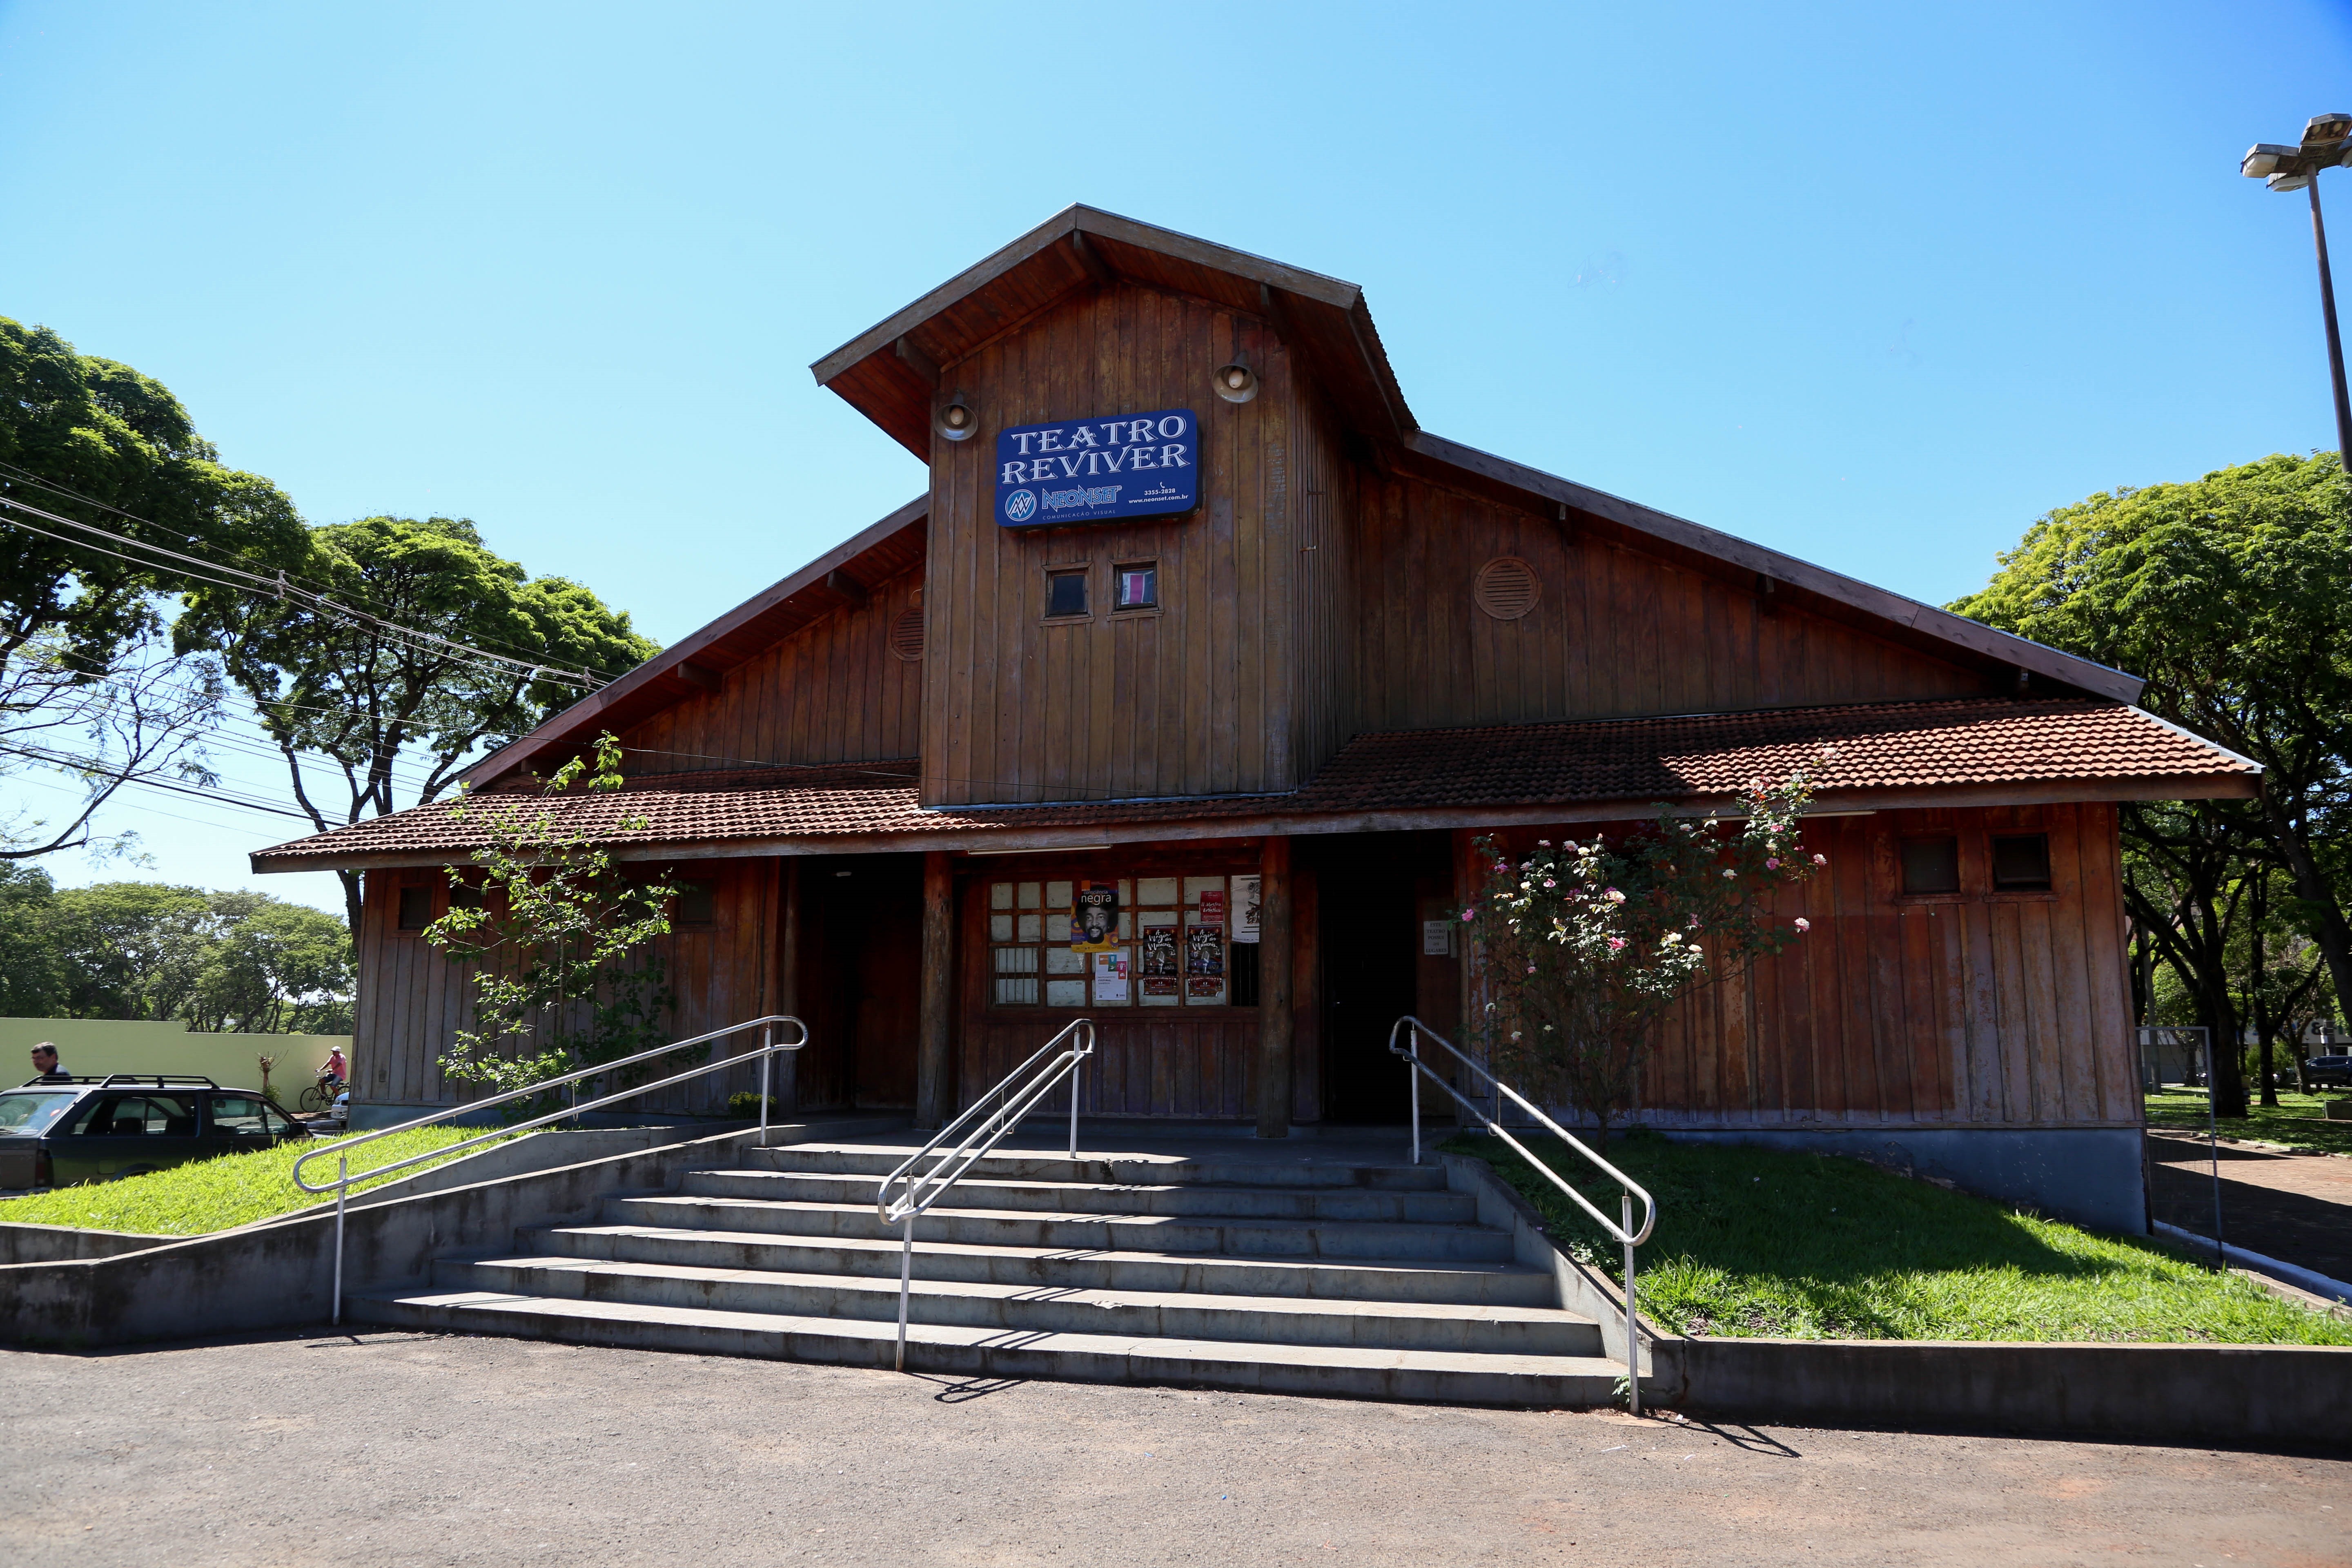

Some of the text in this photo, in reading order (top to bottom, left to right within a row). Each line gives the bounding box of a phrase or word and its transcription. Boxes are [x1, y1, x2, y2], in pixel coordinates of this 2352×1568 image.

[1011, 416, 1186, 455] TEATRO
[1002, 444, 1191, 484] REVIVER
[1129, 493, 1189, 503] www.neonset.com.br
[1081, 895, 1111, 905] negra
[1149, 932, 1171, 943] Magia
[1193, 931, 1215, 943] Magia
